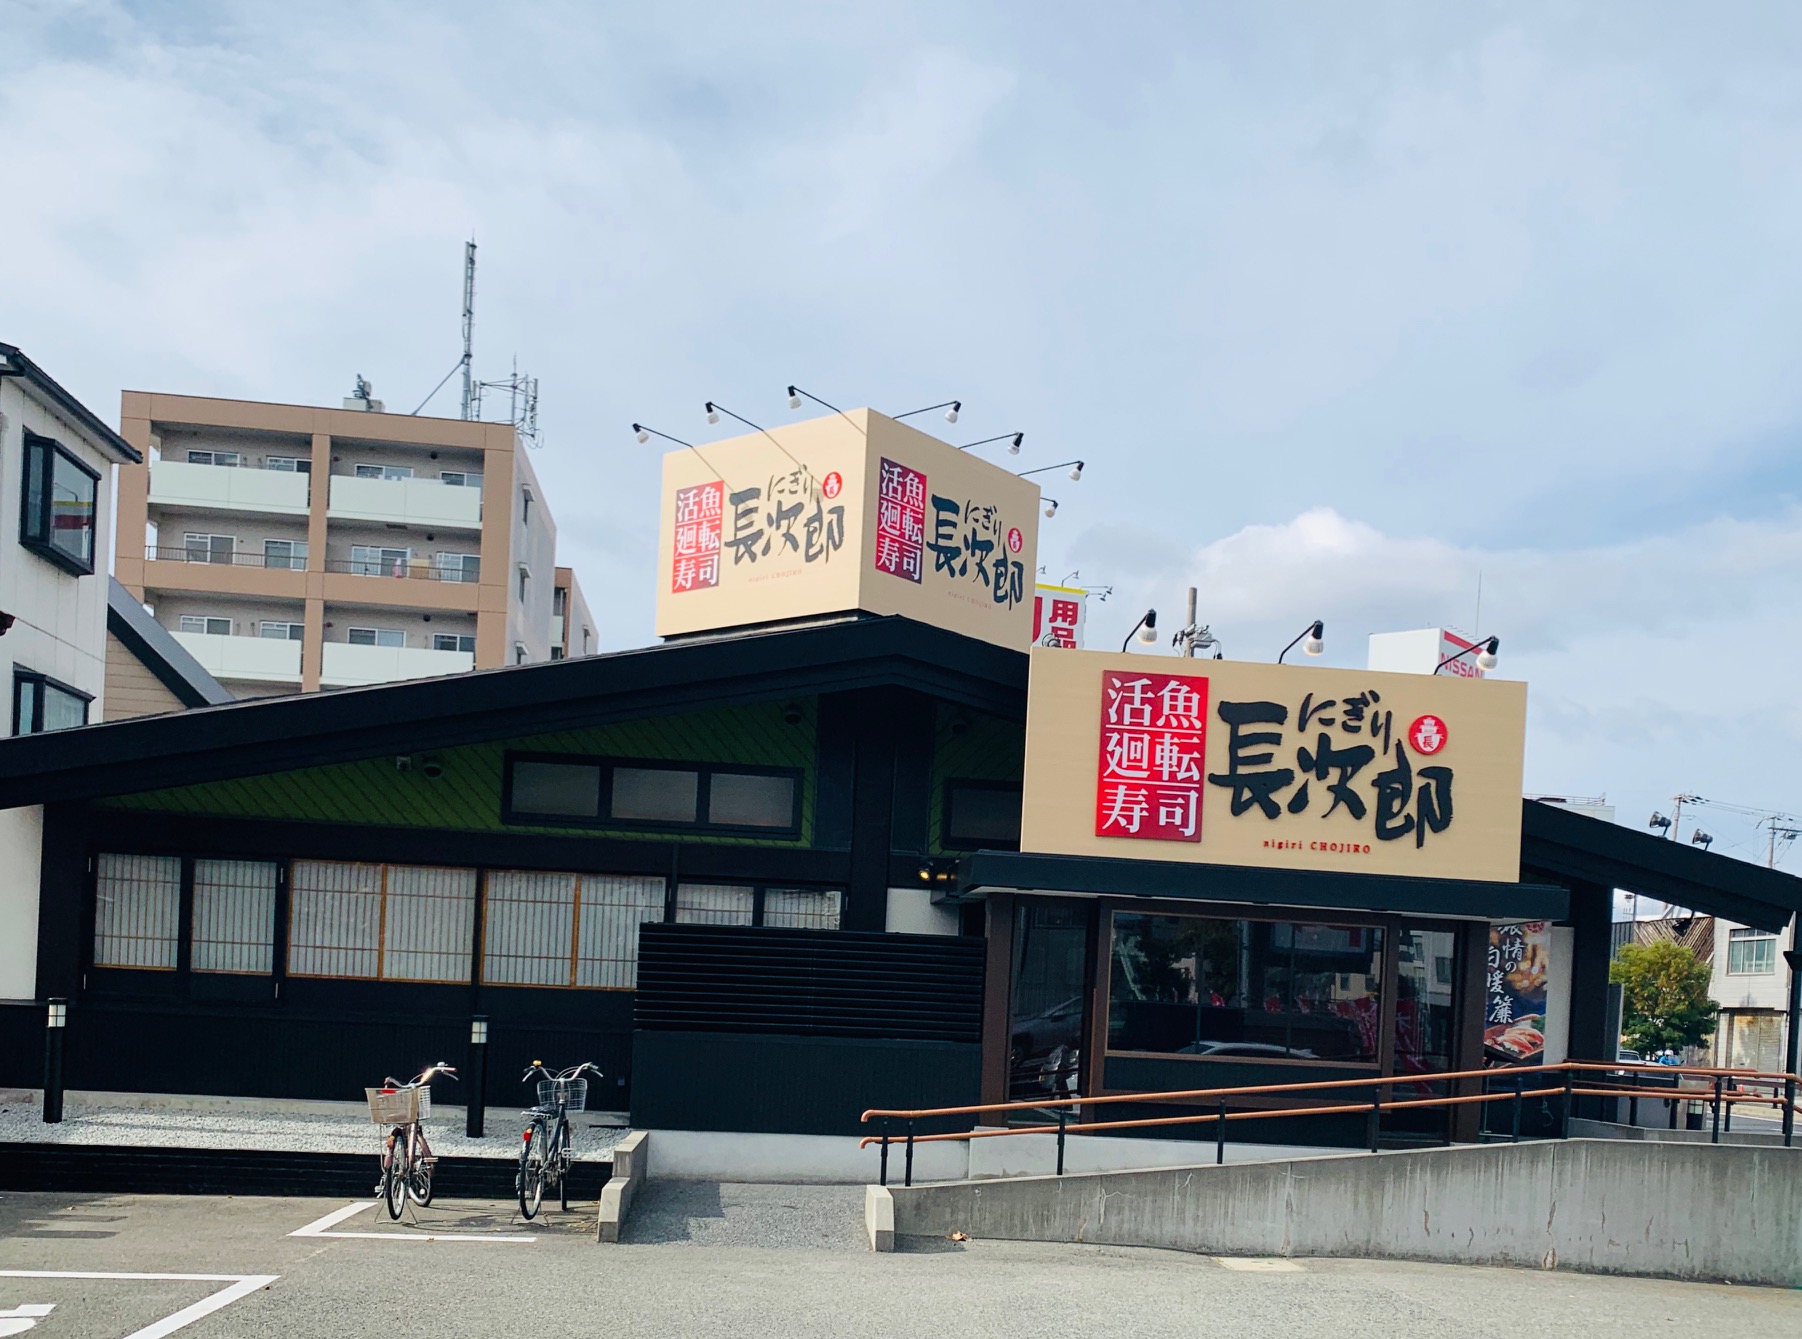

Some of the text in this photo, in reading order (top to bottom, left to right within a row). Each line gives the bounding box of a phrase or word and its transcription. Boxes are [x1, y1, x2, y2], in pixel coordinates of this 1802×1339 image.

[677, 486, 721, 522] 活魚
[768, 464, 813, 504] にぎり
[877, 462, 924, 509] 活魚
[675, 520, 720, 556] 廻転
[724, 488, 845, 565] 長次郎
[879, 499, 923, 544] 廻転
[964, 499, 1002, 547] にぎり
[674, 554, 719, 590] 寿司
[877, 537, 922, 580] 寿司
[926, 493, 1024, 611] 長次郎
[1441, 652, 1484, 679] NISSAN
[1108, 678, 1202, 729] 活魚
[1298, 690, 1392, 755] にぎり
[1103, 732, 1201, 781] 廻転
[1208, 700, 1454, 849] 長次郎
[1102, 785, 1199, 836] 寿司
[1263, 839, 1371, 854] nigiri CHOJIRO
